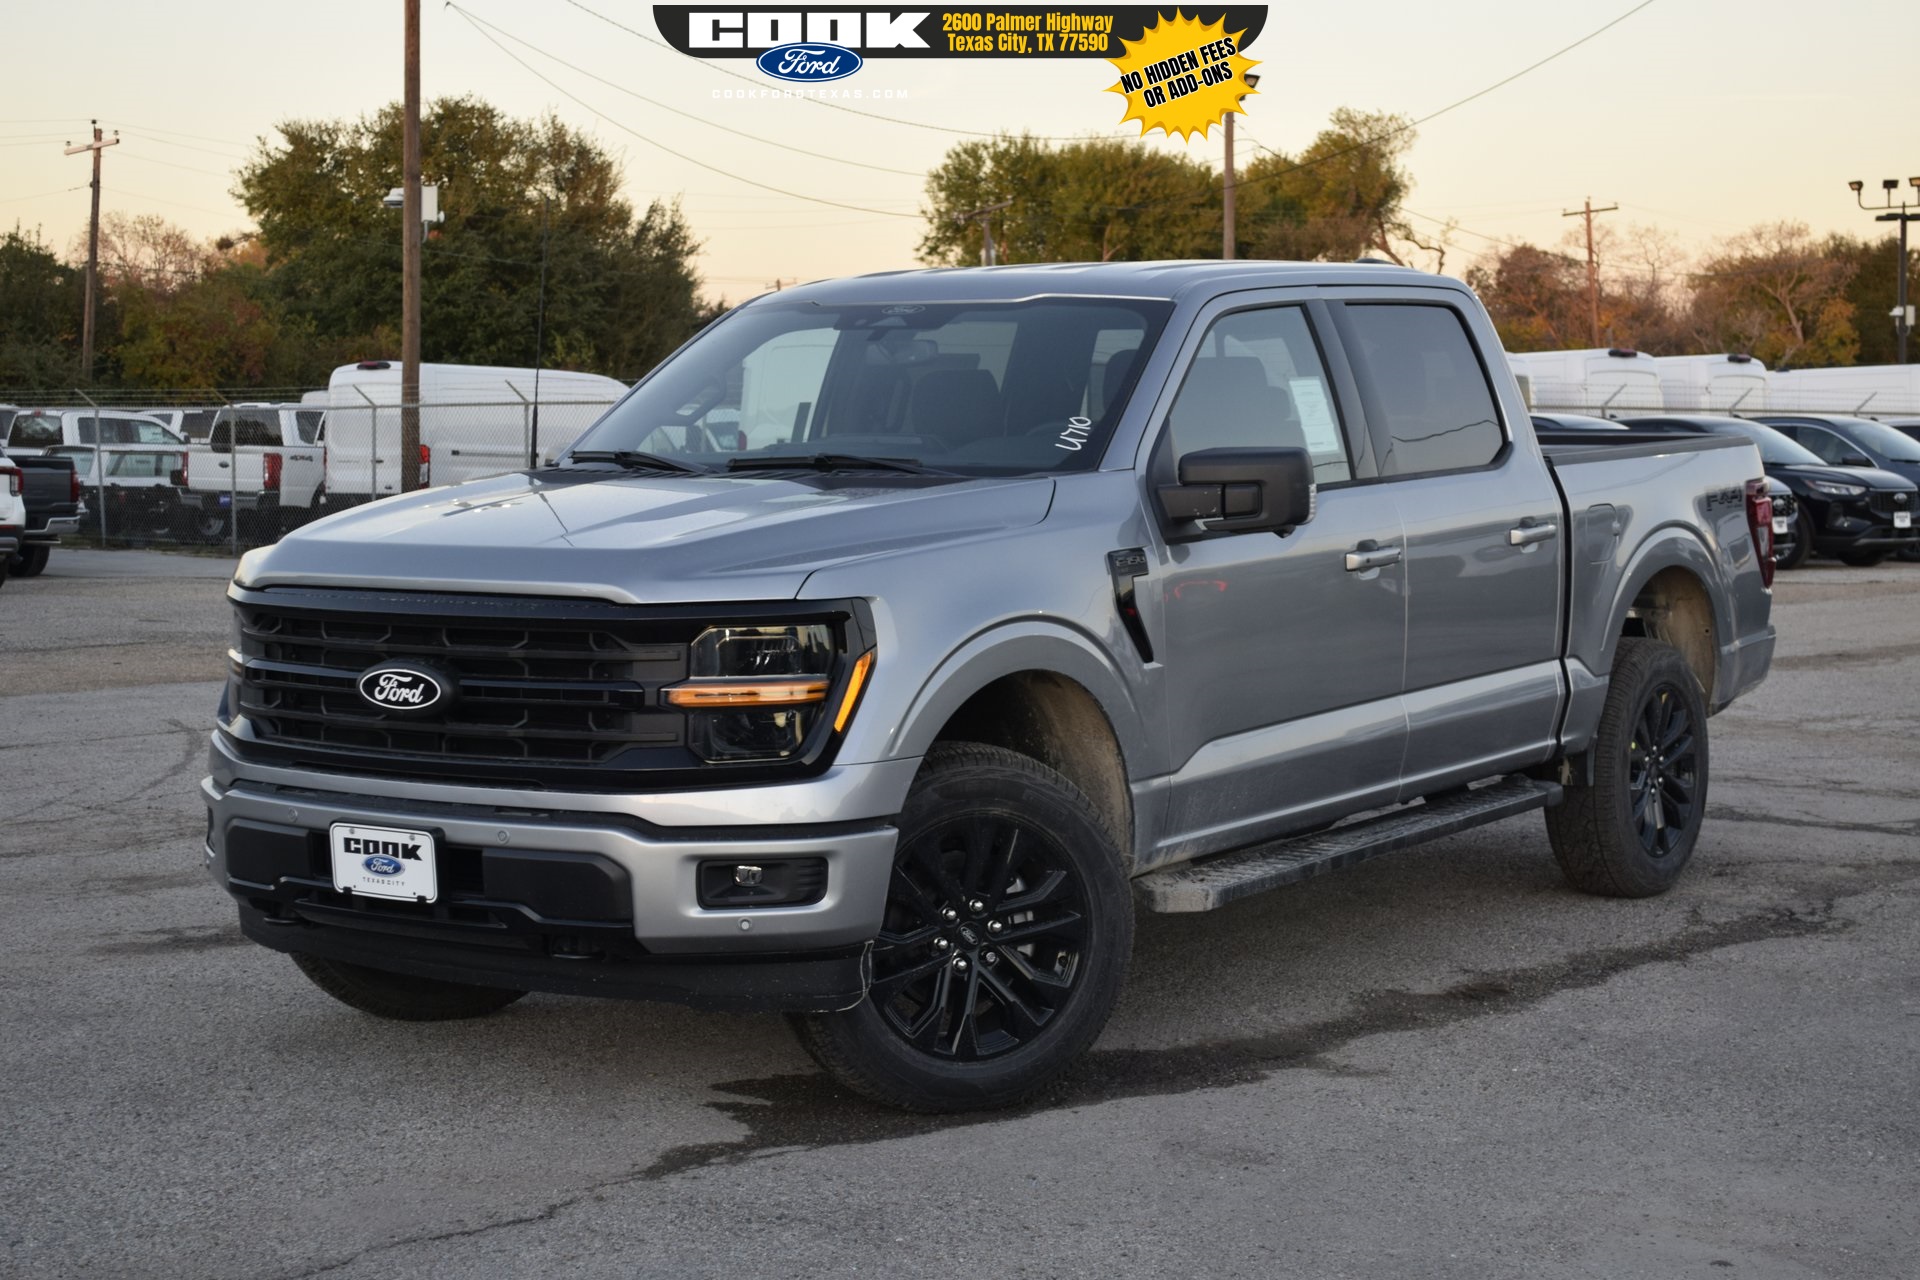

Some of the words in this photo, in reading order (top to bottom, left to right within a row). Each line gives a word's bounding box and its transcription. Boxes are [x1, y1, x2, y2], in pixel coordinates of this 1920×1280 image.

[374, 673, 425, 703] Ford
[343, 837, 423, 861] COOK
[370, 857, 395, 873] Ford
